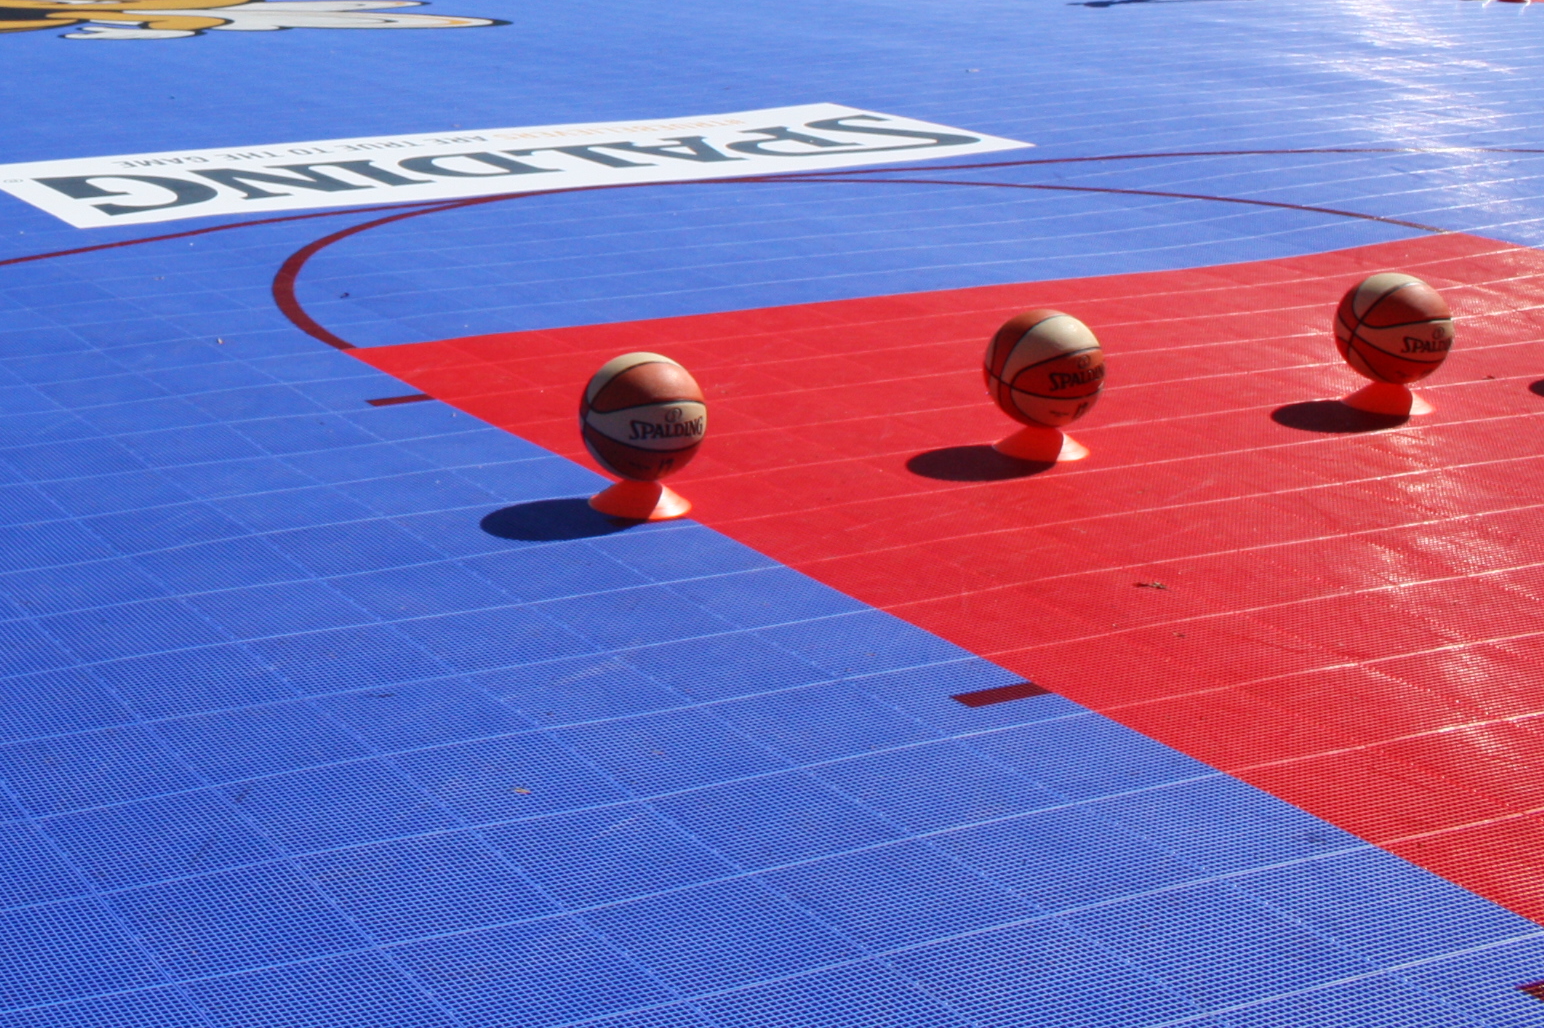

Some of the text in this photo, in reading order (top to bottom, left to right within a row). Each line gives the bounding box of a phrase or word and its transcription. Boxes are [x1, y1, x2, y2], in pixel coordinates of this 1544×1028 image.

[334, 140, 425, 152] TRUE
[424, 134, 489, 146] ARE
[214, 150, 286, 161] THE
[287, 146, 334, 156] TO
[32, 115, 982, 216] SPALDING
[112, 155, 210, 169] GAME
[628, 416, 704, 440] SPALDING
